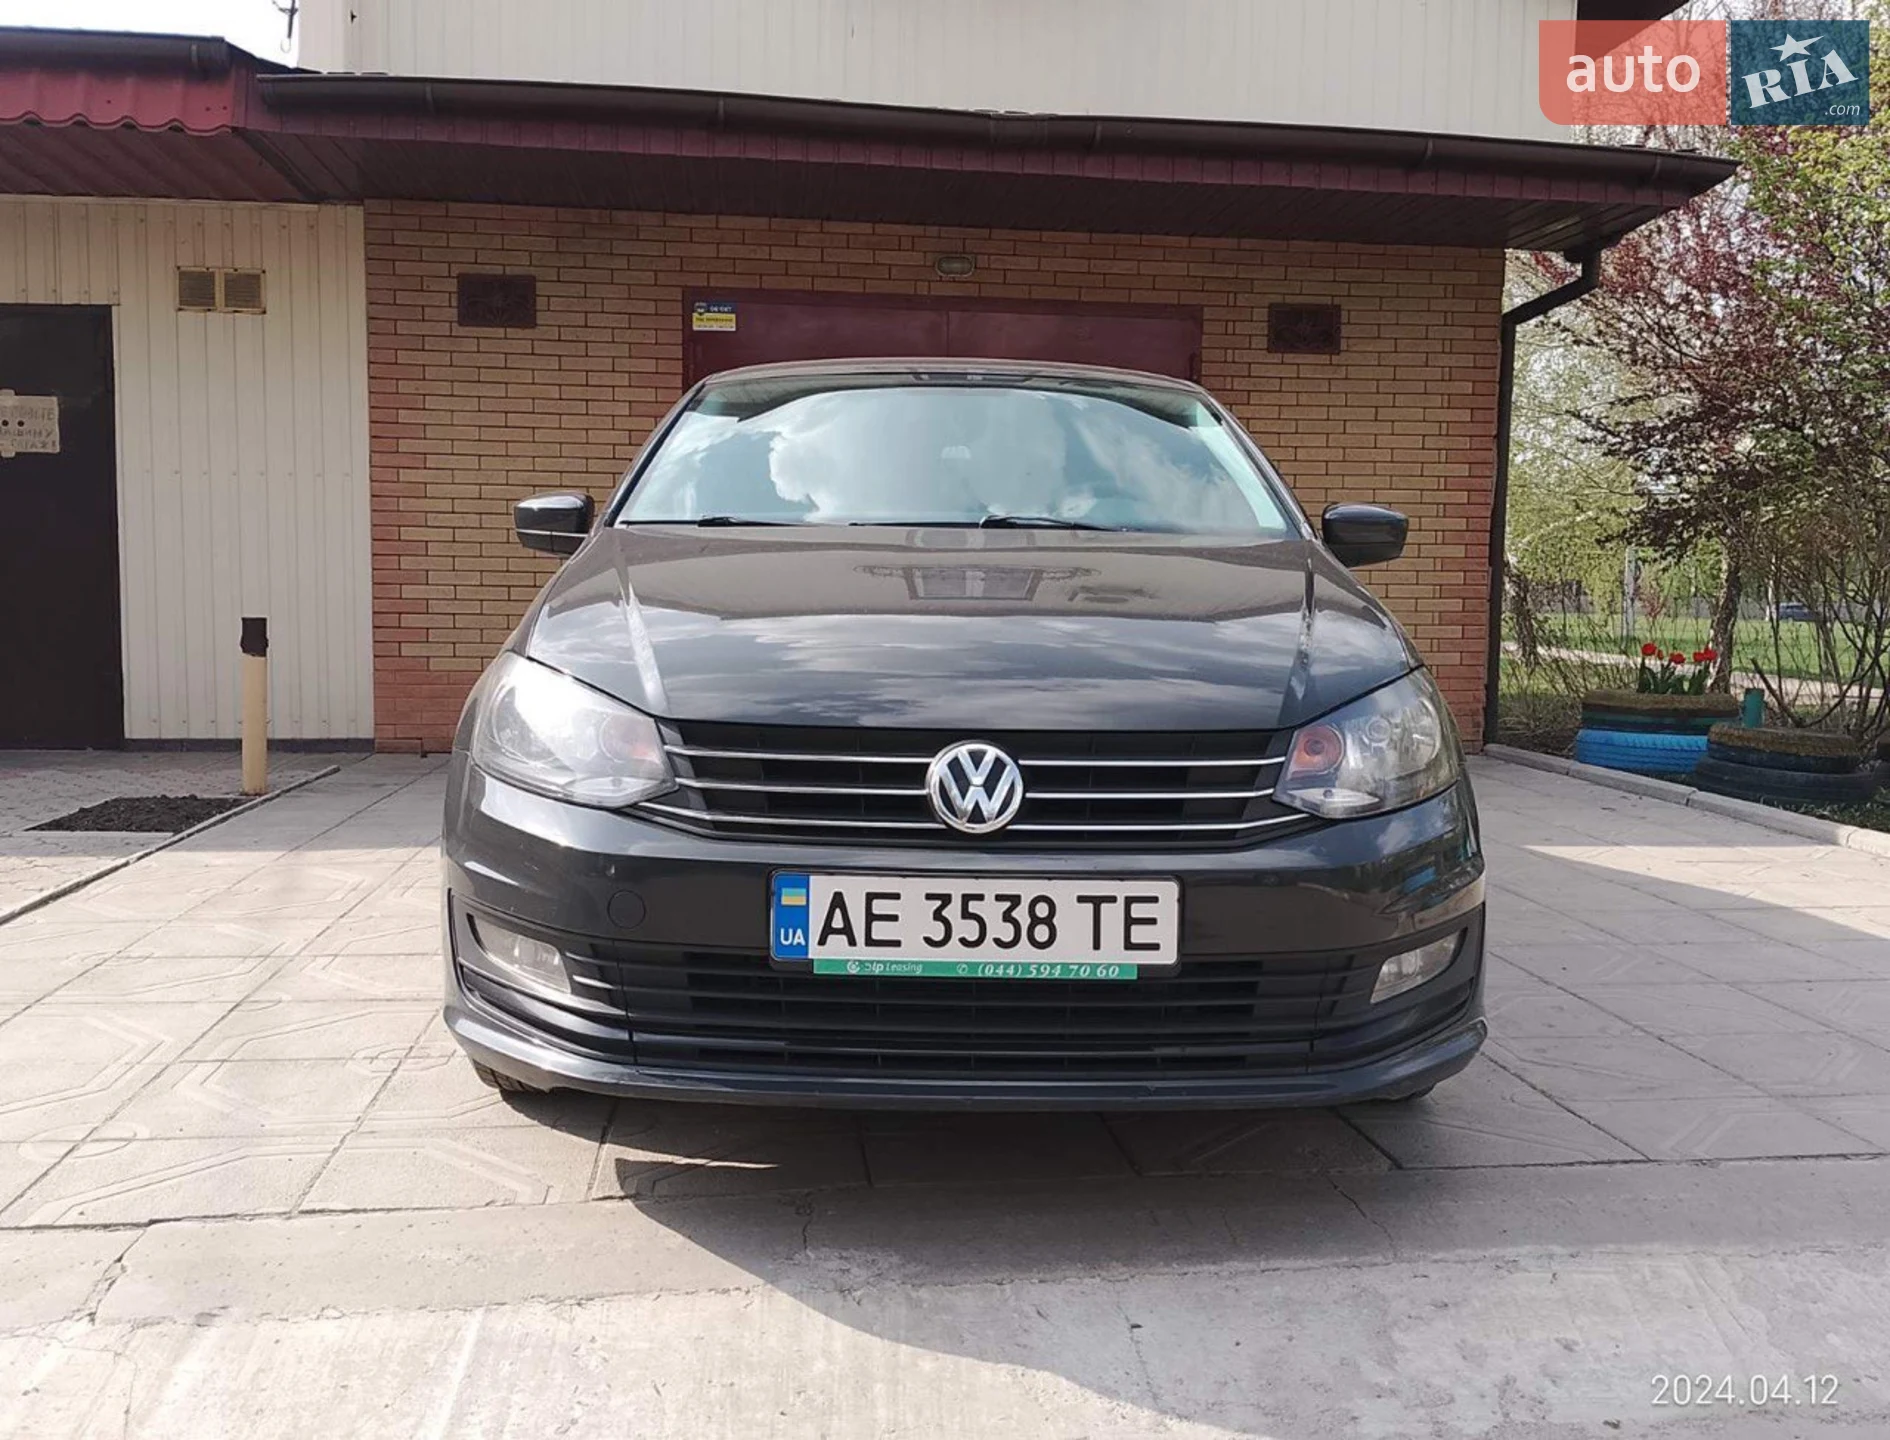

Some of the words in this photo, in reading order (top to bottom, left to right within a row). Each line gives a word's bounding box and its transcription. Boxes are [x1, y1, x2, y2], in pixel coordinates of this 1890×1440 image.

[816, 890, 902, 948] AE
[922, 892, 1058, 951] 3538
[1076, 894, 1162, 952] TE
[780, 928, 806, 946] UA
[978, 963, 1022, 977] (044)
[1028, 964, 1062, 978] 594
[1068, 965, 1091, 978] 70
[1096, 965, 1120, 978] 60
